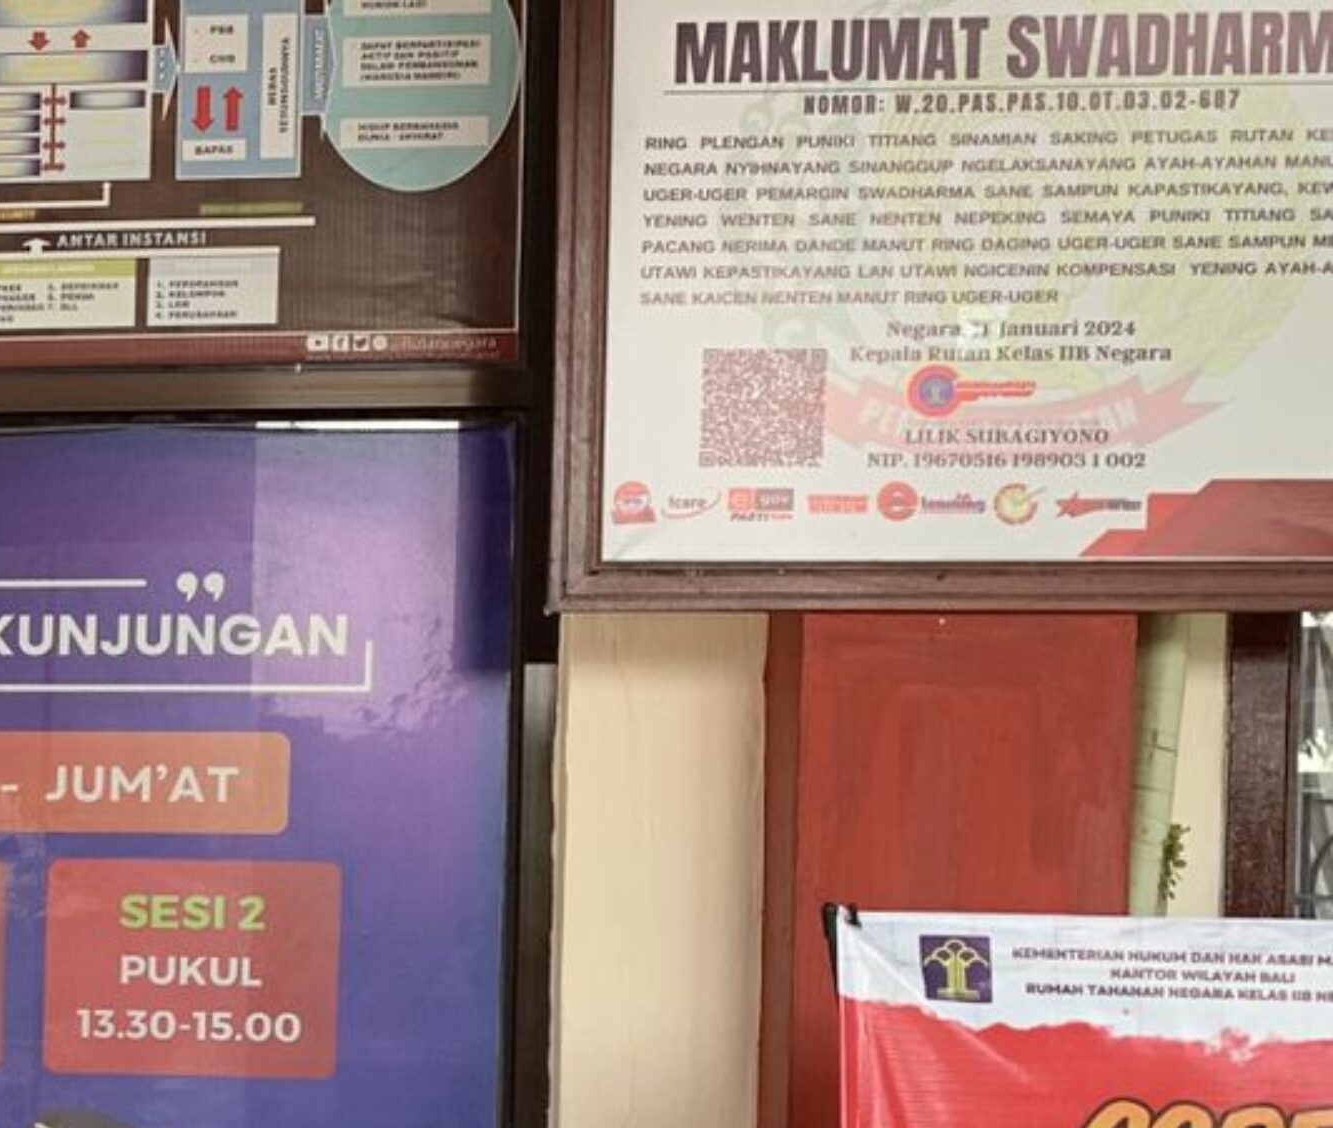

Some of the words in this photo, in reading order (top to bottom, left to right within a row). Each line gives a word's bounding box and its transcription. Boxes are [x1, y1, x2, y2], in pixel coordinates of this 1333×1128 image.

[675, 17, 989, 84] MAKLUMAT
[804, 95, 883, 114] NOMOR:
[645, 137, 687, 150] RING
[701, 135, 785, 150] PLENGAN
[797, 134, 855, 148] PUNIKI
[869, 133, 937, 147] TITIANG
[1050, 131, 1118, 145] SAKING
[1131, 130, 1218, 145] PETUGAS
[1230, 128, 1294, 143] RUTAN
[644, 162, 717, 176] NEGARA
[57, 233, 118, 247] ANTAR
[122, 232, 207, 246] INSTANSI
[1000, 319, 1078, 338] Januari
[1084, 321, 1136, 336] 2024
[850, 345, 922, 365] Kepala
[996, 345, 1054, 361] Kelas
[1059, 346, 1090, 361] IIB
[1096, 346, 1171, 365] Negara
[905, 429, 960, 445] LILIK
[967, 429, 1109, 444] SUBAGIYONO
[867, 452, 907, 468] NIP.
[914, 451, 1007, 468] 19670516
[1012, 452, 1086, 468] 198903
[1105, 453, 1146, 468] 002
[46, 764, 240, 803] JUM'AT
[120, 895, 225, 929] SESI
[238, 896, 264, 930] 2
[1012, 947, 1124, 961] KEMENTERIAN
[1128, 951, 1187, 963] HUKUM
[1190, 952, 1225, 963] DAN
[1229, 953, 1262, 964] HAK
[1266, 954, 1314, 966] ASASI
[121, 955, 261, 986] PUKUL
[1110, 968, 1177, 980] KANTOR
[1182, 971, 1256, 982] WILAYAH
[1260, 972, 1295, 984] BALI
[1026, 983, 1083, 995] RUMAH
[1087, 985, 1164, 998] TAHANAN
[1168, 987, 1235, 1000] NEGARA
[1237, 989, 1288, 1001] KELAS
[77, 1009, 301, 1042] 13.30-15.00
